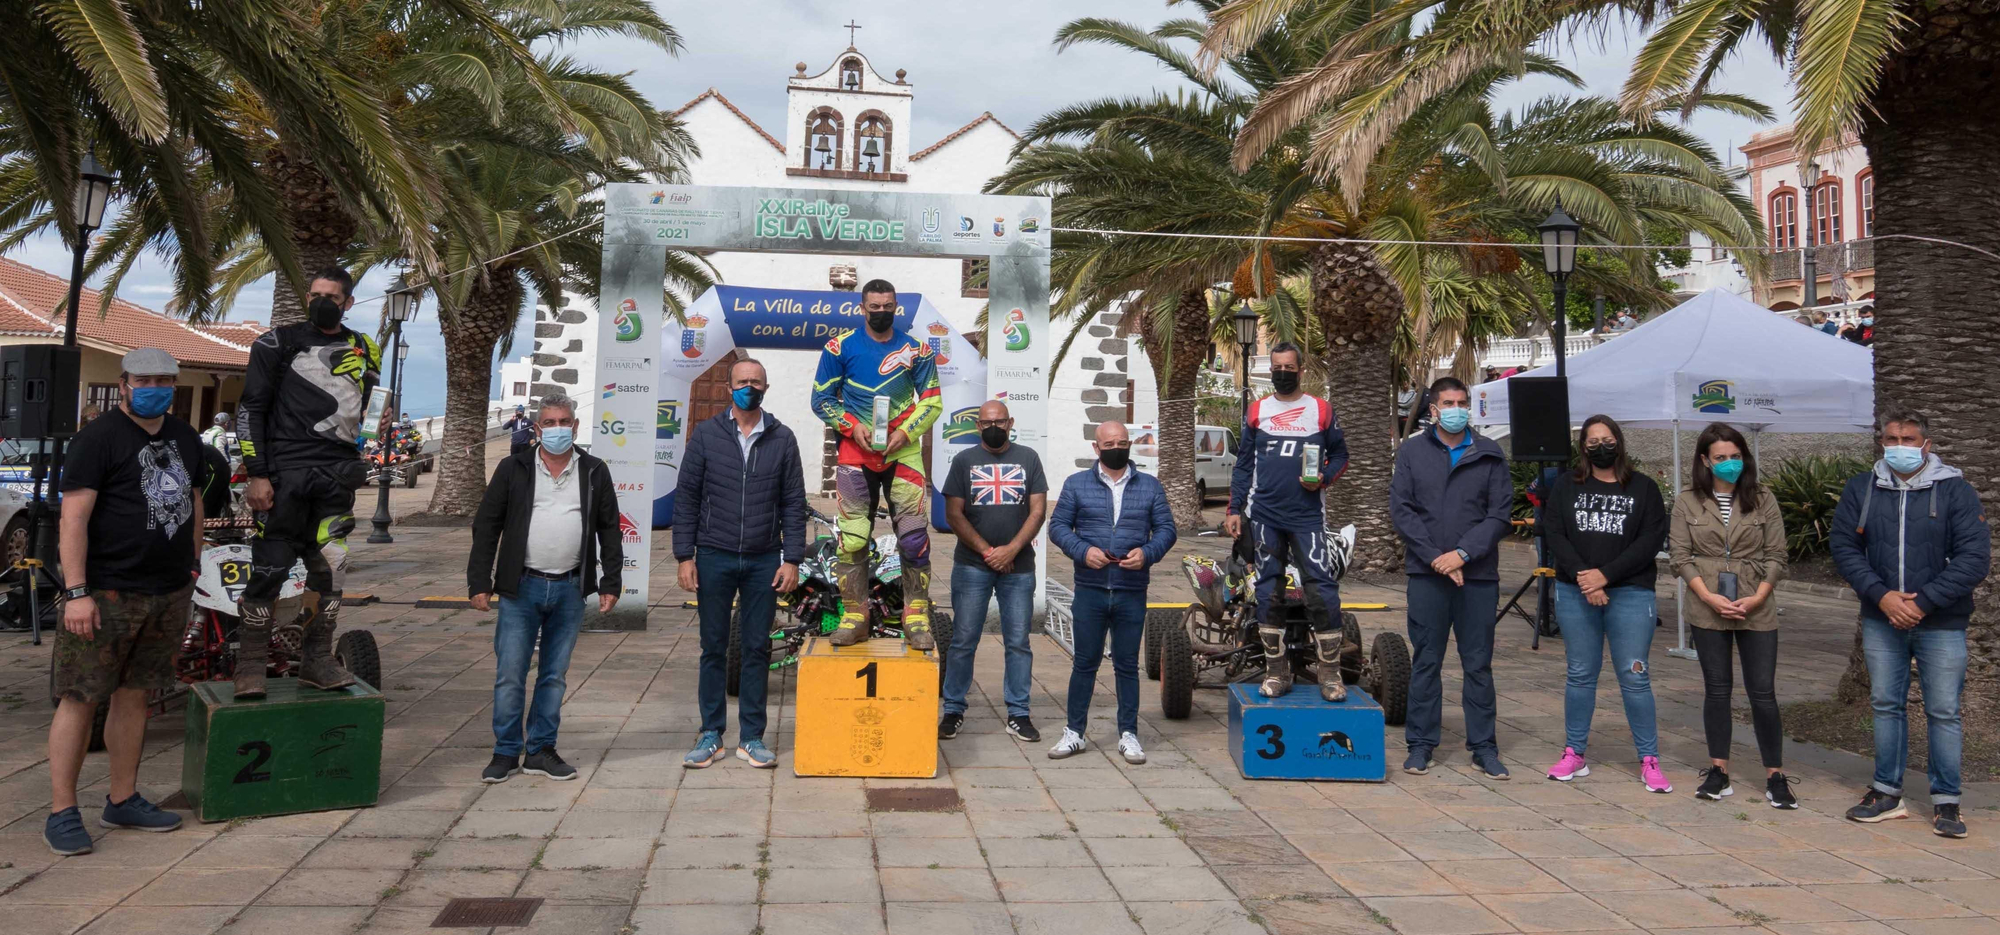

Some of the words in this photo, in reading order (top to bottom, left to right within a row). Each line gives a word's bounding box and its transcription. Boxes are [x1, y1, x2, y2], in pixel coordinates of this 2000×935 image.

[669, 193, 692, 204] fialp
[657, 227, 689, 239] 2021
[756, 214, 812, 238] ISLA
[818, 216, 904, 241] VERDE
[953, 231, 980, 239] deportes
[734, 298, 756, 313] La
[764, 299, 802, 314] Villa
[810, 300, 832, 315] de
[752, 323, 785, 336] con
[791, 321, 808, 337] el
[617, 383, 650, 393] sastre
[1008, 391, 1040, 401] sastre
[600, 420, 625, 435] SG
[1573, 493, 1634, 513] AFTER
[1575, 510, 1627, 535] DARK
[222, 562, 252, 584] 31
[855, 662, 878, 698] 1
[1256, 723, 1286, 760] 3
[232, 740, 272, 784] 2
